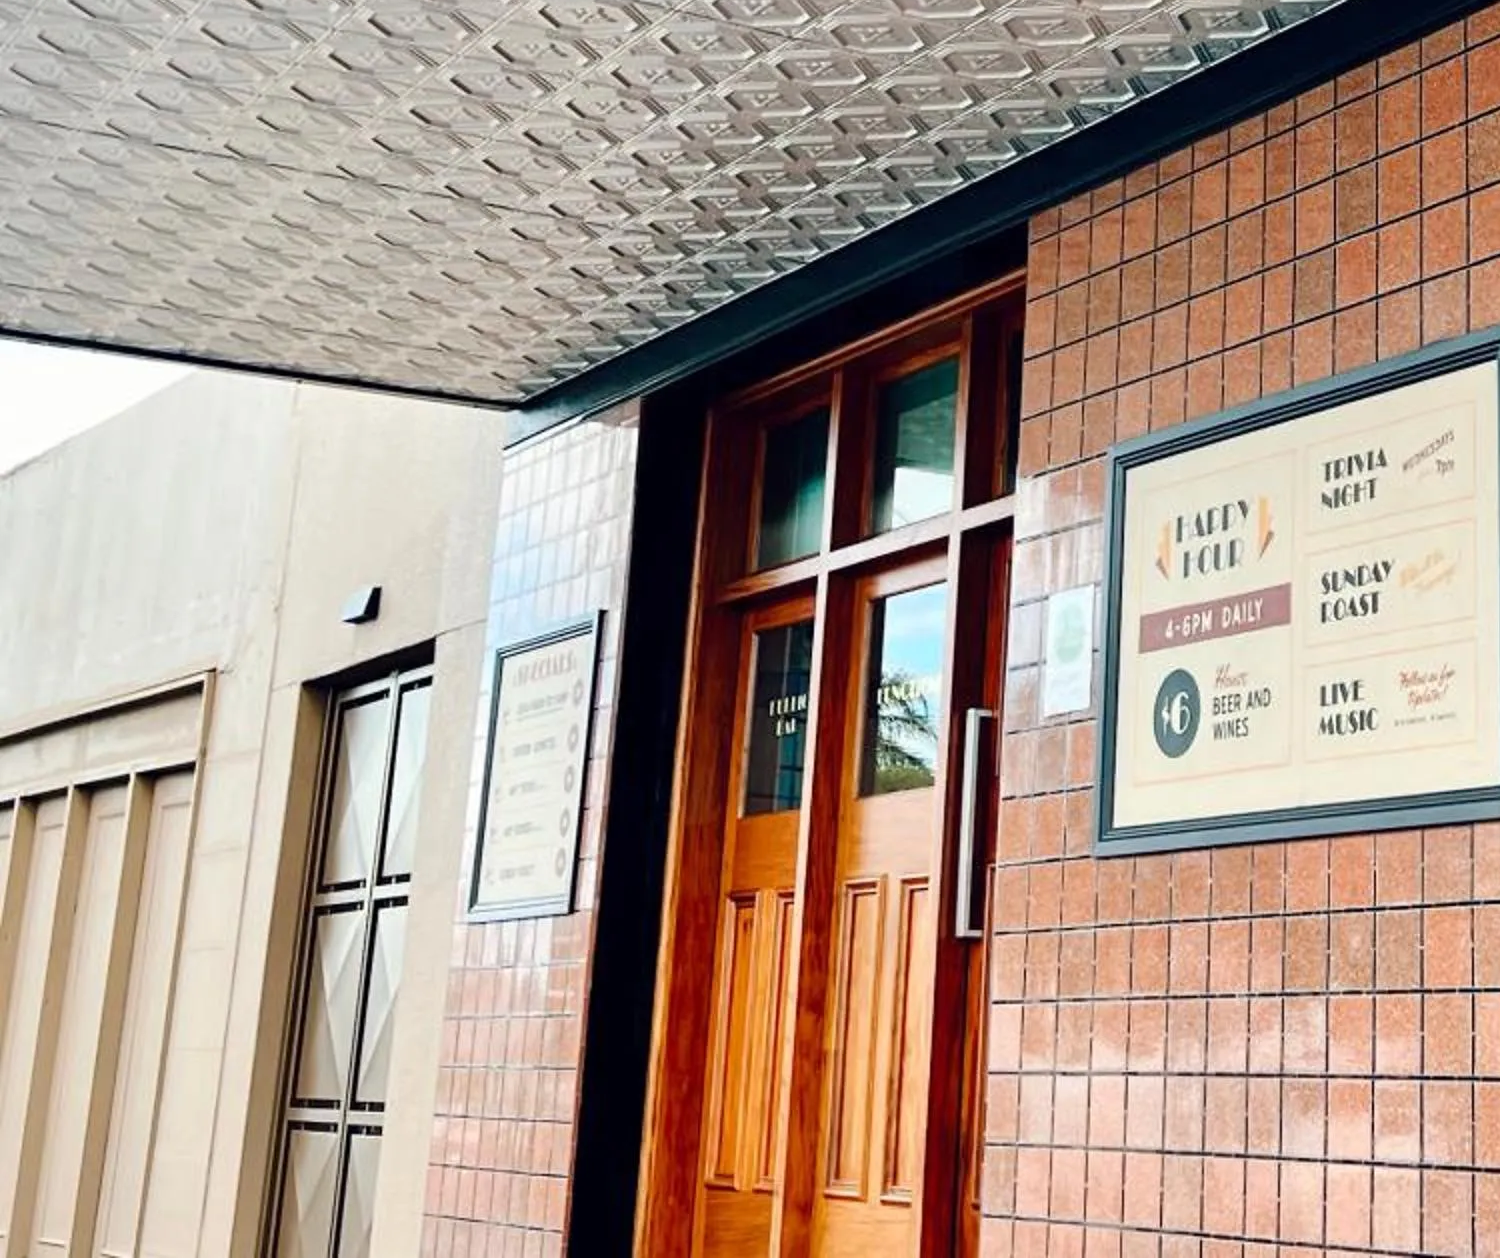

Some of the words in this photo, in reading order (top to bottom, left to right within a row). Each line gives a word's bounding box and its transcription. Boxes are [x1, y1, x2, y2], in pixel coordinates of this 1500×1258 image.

[1322, 446, 1388, 482] TRIVIA
[1321, 477, 1377, 510] NIGHT
[1176, 499, 1253, 543] HAPPY
[1183, 538, 1245, 578] HOUR
[1321, 558, 1396, 594] SUNDAY
[1165, 609, 1213, 639] 4-6PM
[1221, 597, 1264, 629] DAILY
[1321, 591, 1380, 624] ROAST
[1212, 693, 1242, 716] BEER
[1246, 686, 1271, 710] AND
[1320, 679, 1365, 707] LIVE
[1212, 717, 1249, 741] WINES
[1318, 708, 1379, 736] MUSIC
